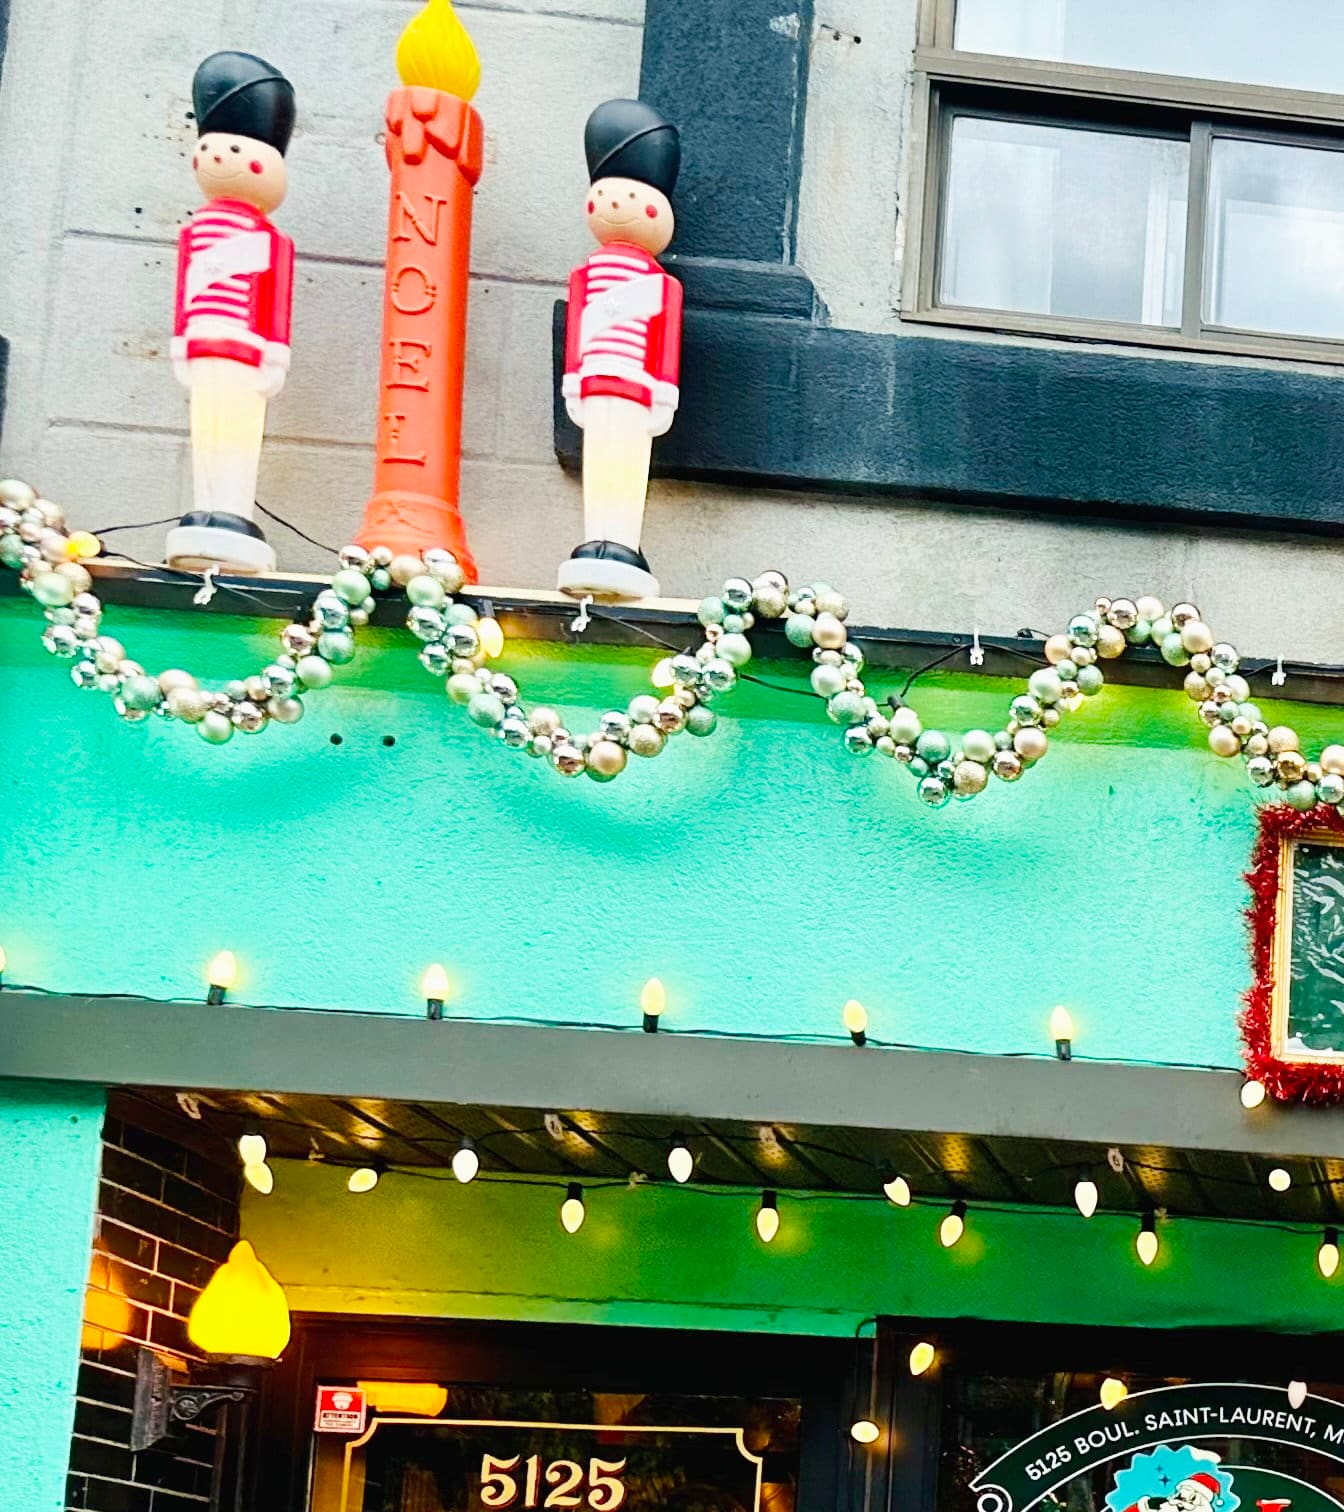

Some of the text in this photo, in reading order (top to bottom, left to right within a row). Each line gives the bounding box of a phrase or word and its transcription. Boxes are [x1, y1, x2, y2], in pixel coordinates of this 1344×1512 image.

[383, 192, 447, 467] NOEL
[1025, 1447, 1072, 1482] 5125
[1075, 1424, 1140, 1454] BOUL.
[1144, 1406, 1318, 1442] SAINT-LAURENT,
[479, 1454, 628, 1512] 5125
